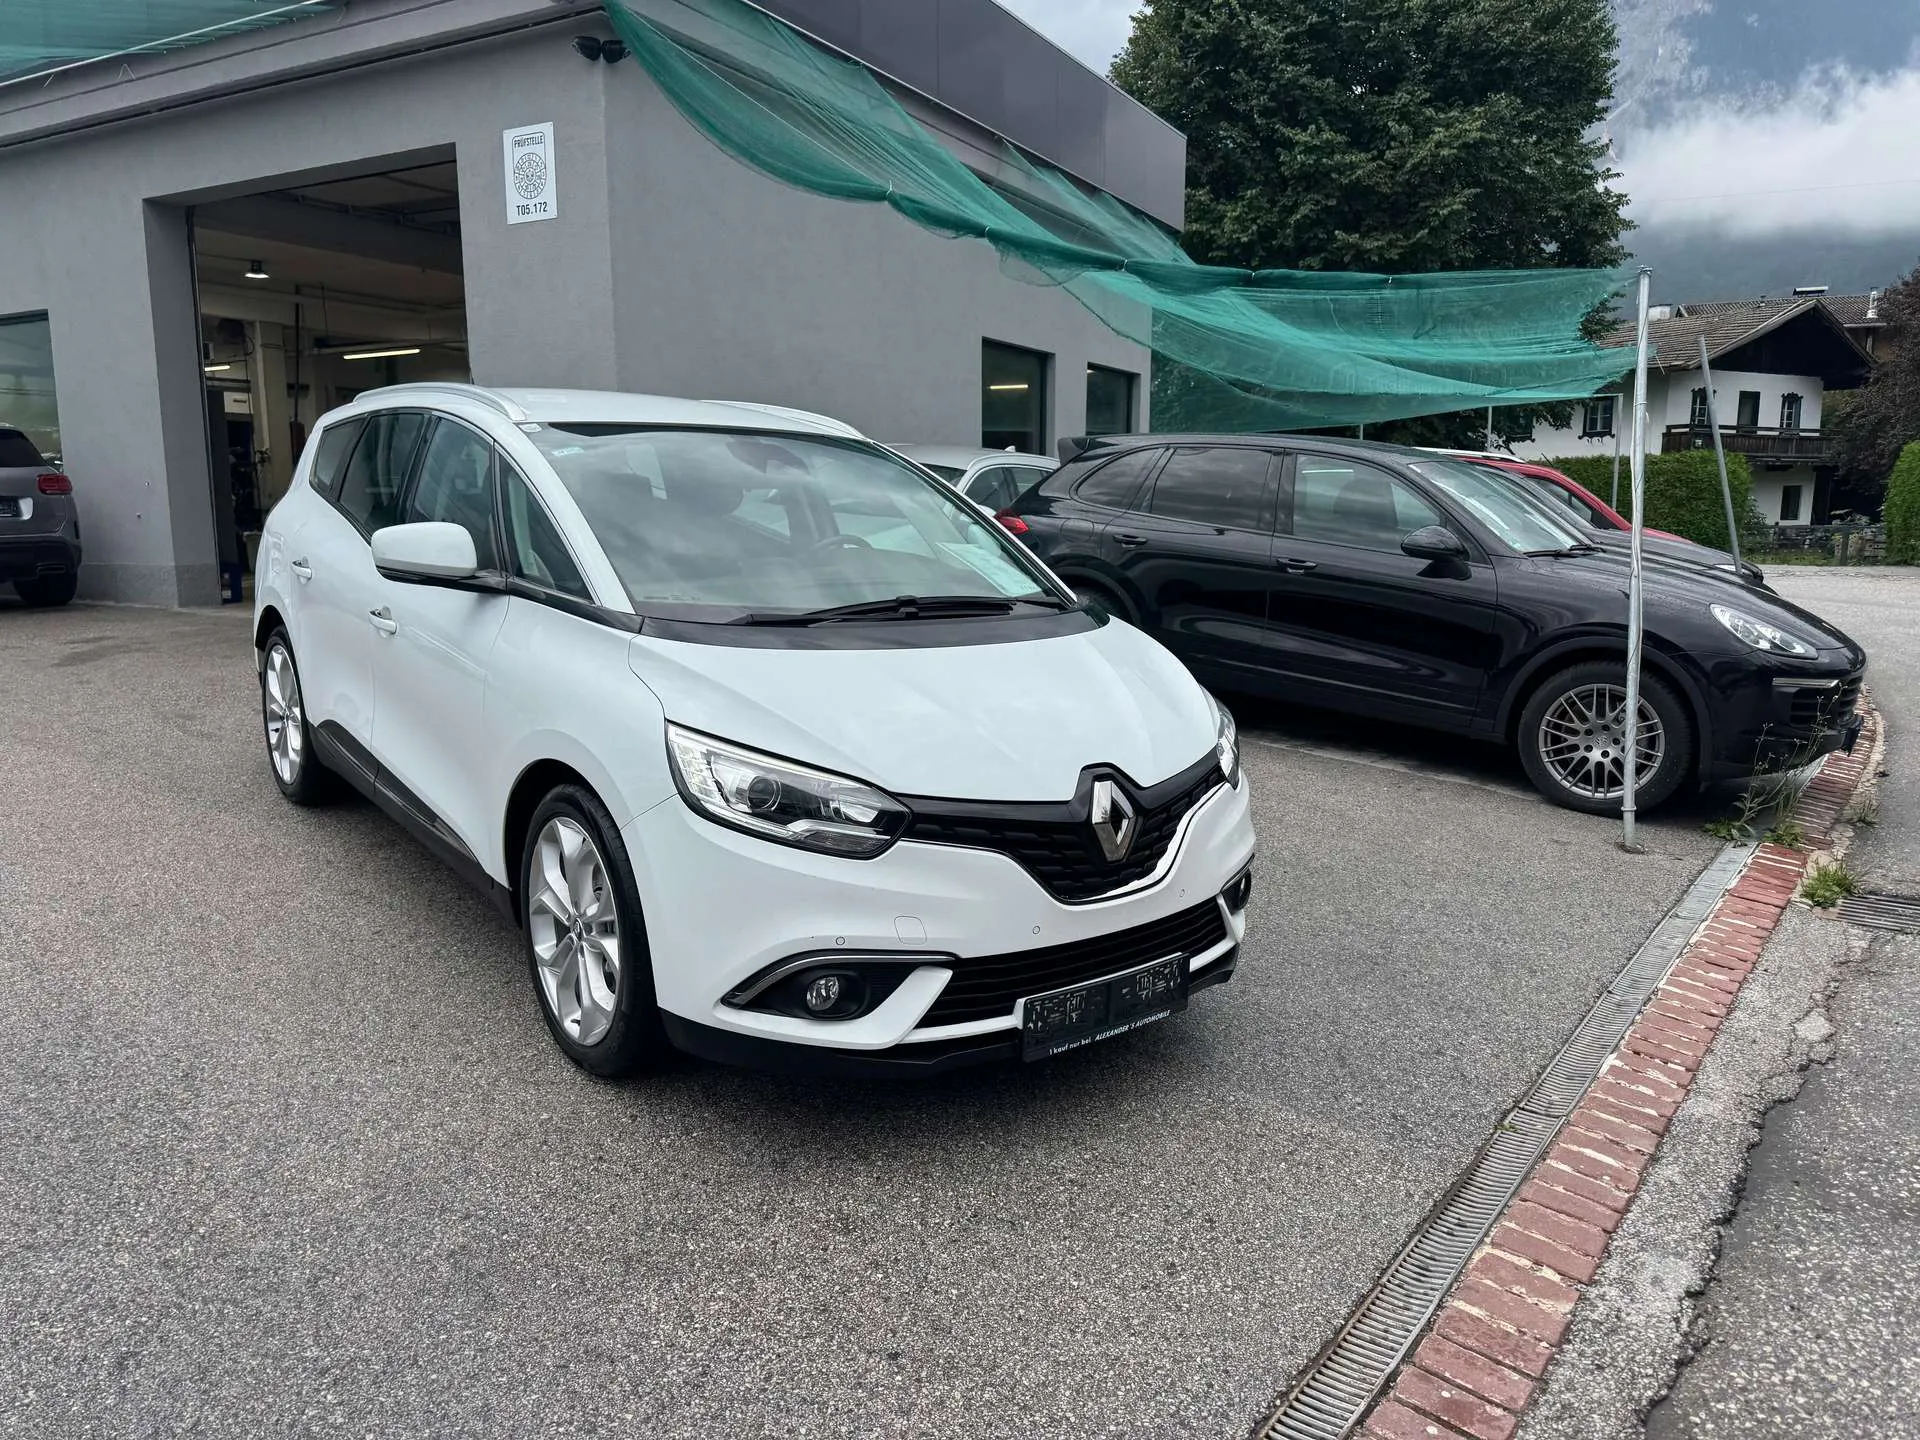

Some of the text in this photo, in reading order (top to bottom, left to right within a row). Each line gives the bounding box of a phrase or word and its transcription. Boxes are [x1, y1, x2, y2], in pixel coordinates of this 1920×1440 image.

[513, 135, 544, 148] PRÜFSTELLE
[516, 201, 548, 217] T05.172
[1053, 1042, 1069, 1054] kauf
[1069, 1041, 1080, 1049] nur
[1081, 1036, 1092, 1045] bei
[1135, 1009, 1171, 1028] AUTOMOBILE
